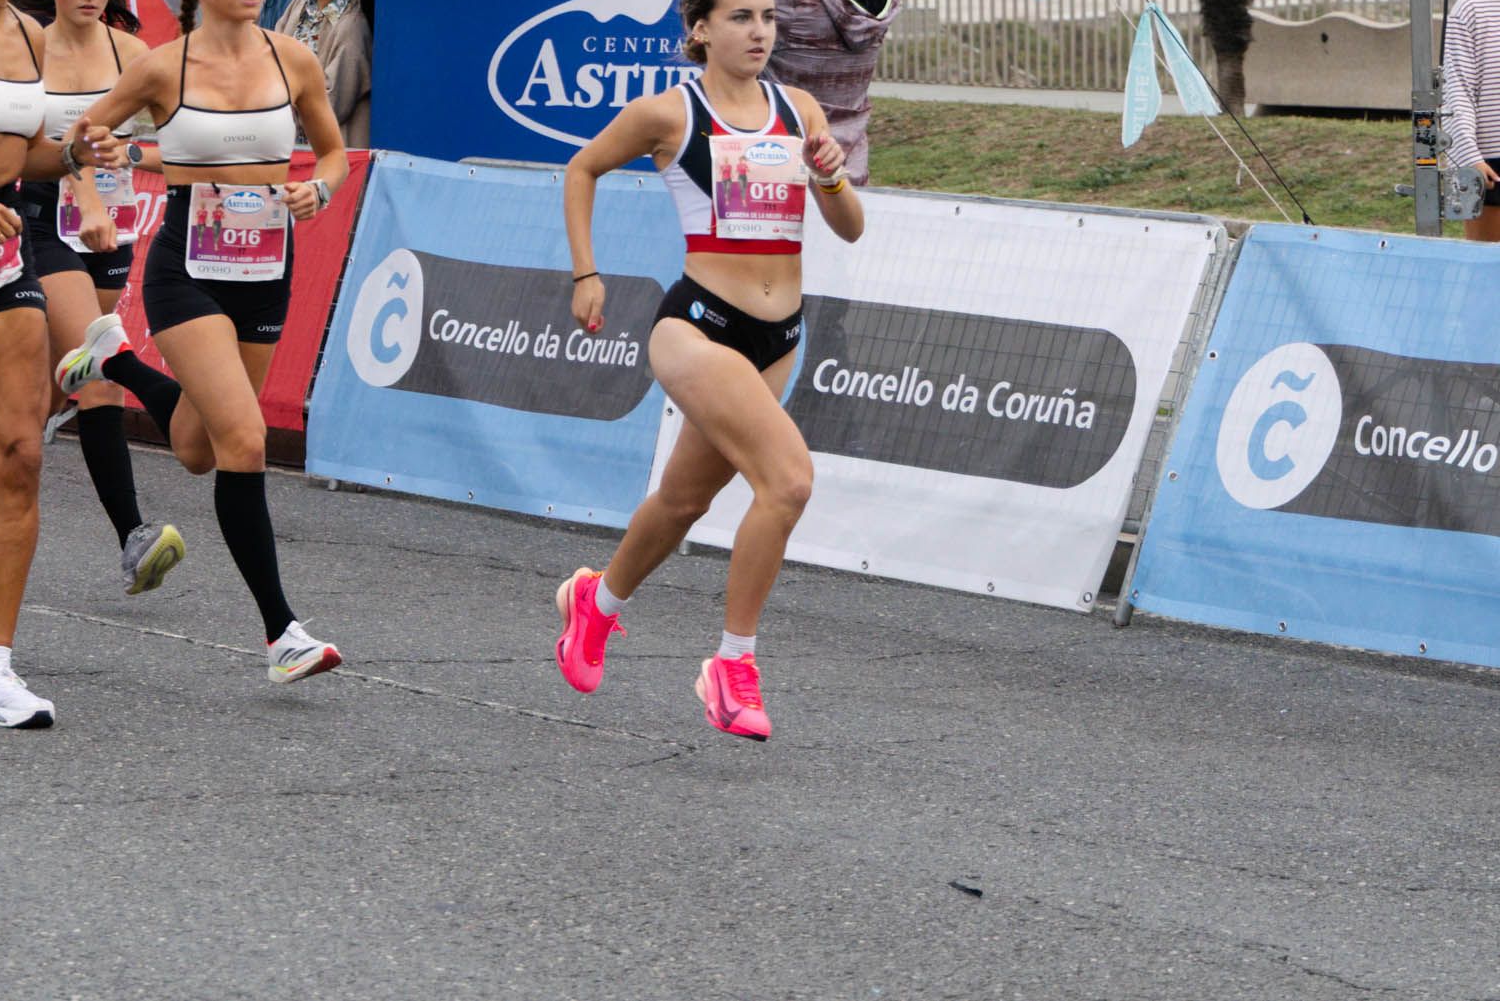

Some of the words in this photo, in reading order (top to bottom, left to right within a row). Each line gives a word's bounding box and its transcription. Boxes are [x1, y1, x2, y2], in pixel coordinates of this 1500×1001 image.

[583, 37, 684, 53] CENTRA
[749, 183, 788, 201] 016
[727, 223, 762, 232] OYSHO
[222, 228, 261, 246] 016
[429, 309, 529, 356] Concello
[533, 324, 560, 359] da
[565, 328, 640, 367] Coruña
[812, 358, 934, 407] Concello
[941, 374, 979, 413] da
[987, 381, 1096, 429] Coruña
[1354, 414, 1498, 473] Concello
